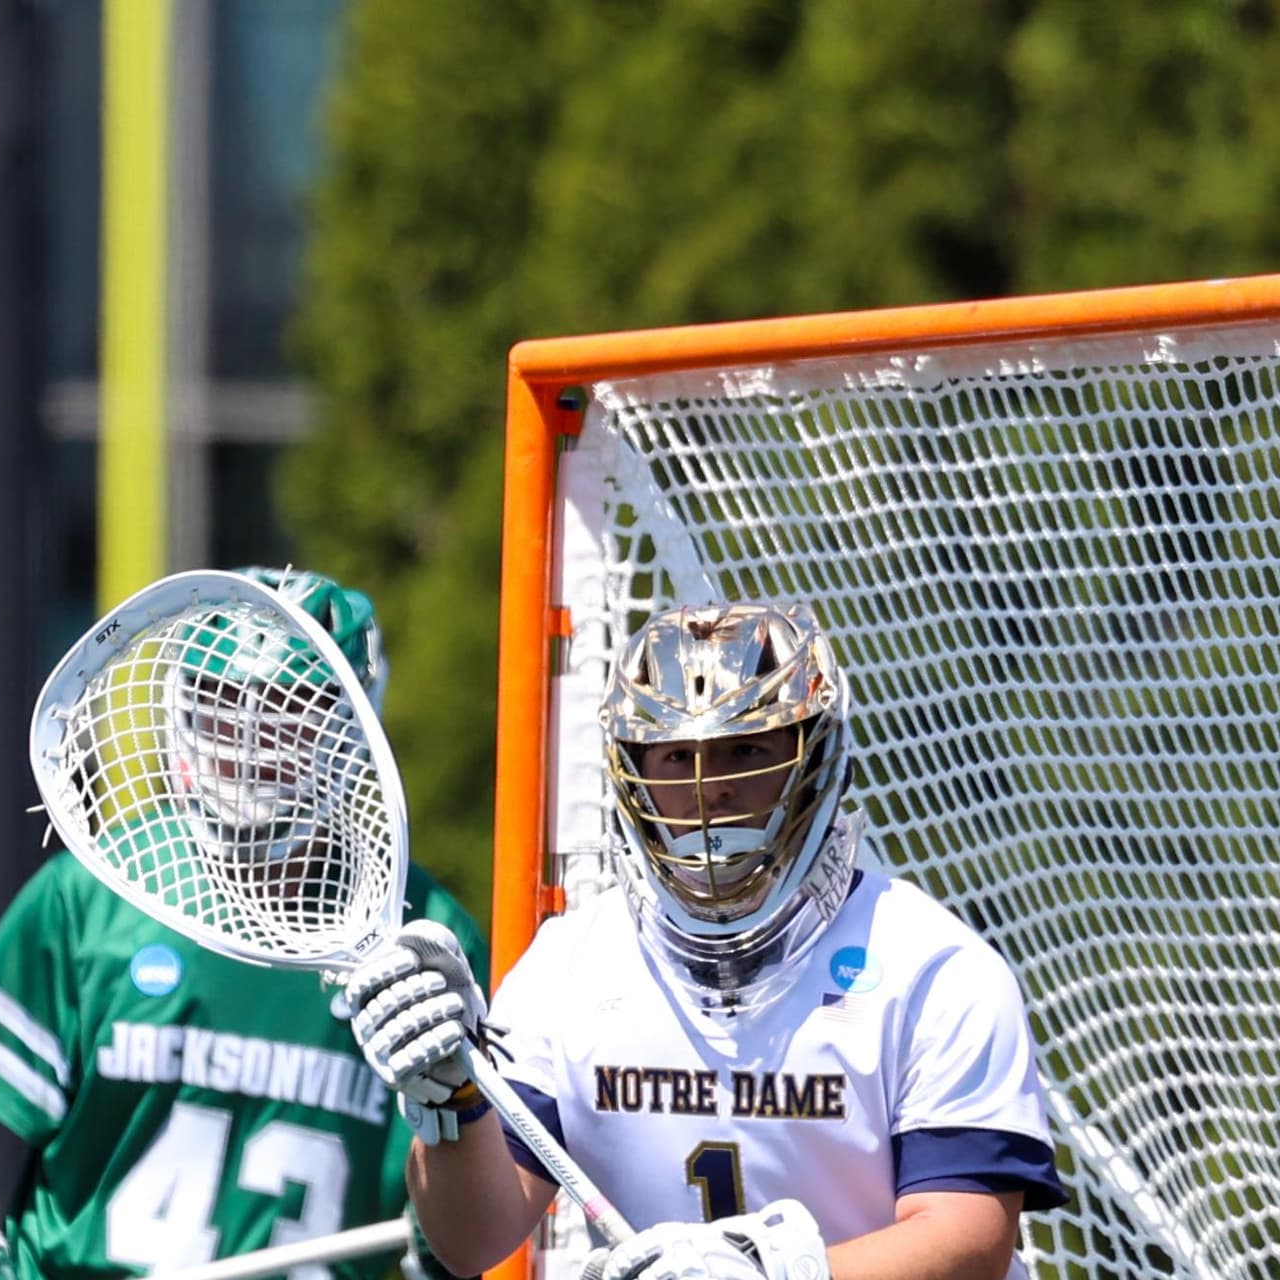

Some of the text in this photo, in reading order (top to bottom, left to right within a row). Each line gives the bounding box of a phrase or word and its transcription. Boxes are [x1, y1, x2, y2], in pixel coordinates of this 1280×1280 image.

[95, 619, 121, 645] STX
[354, 928, 380, 953] STX
[594, 1065, 846, 1121] NOTRE DAME
